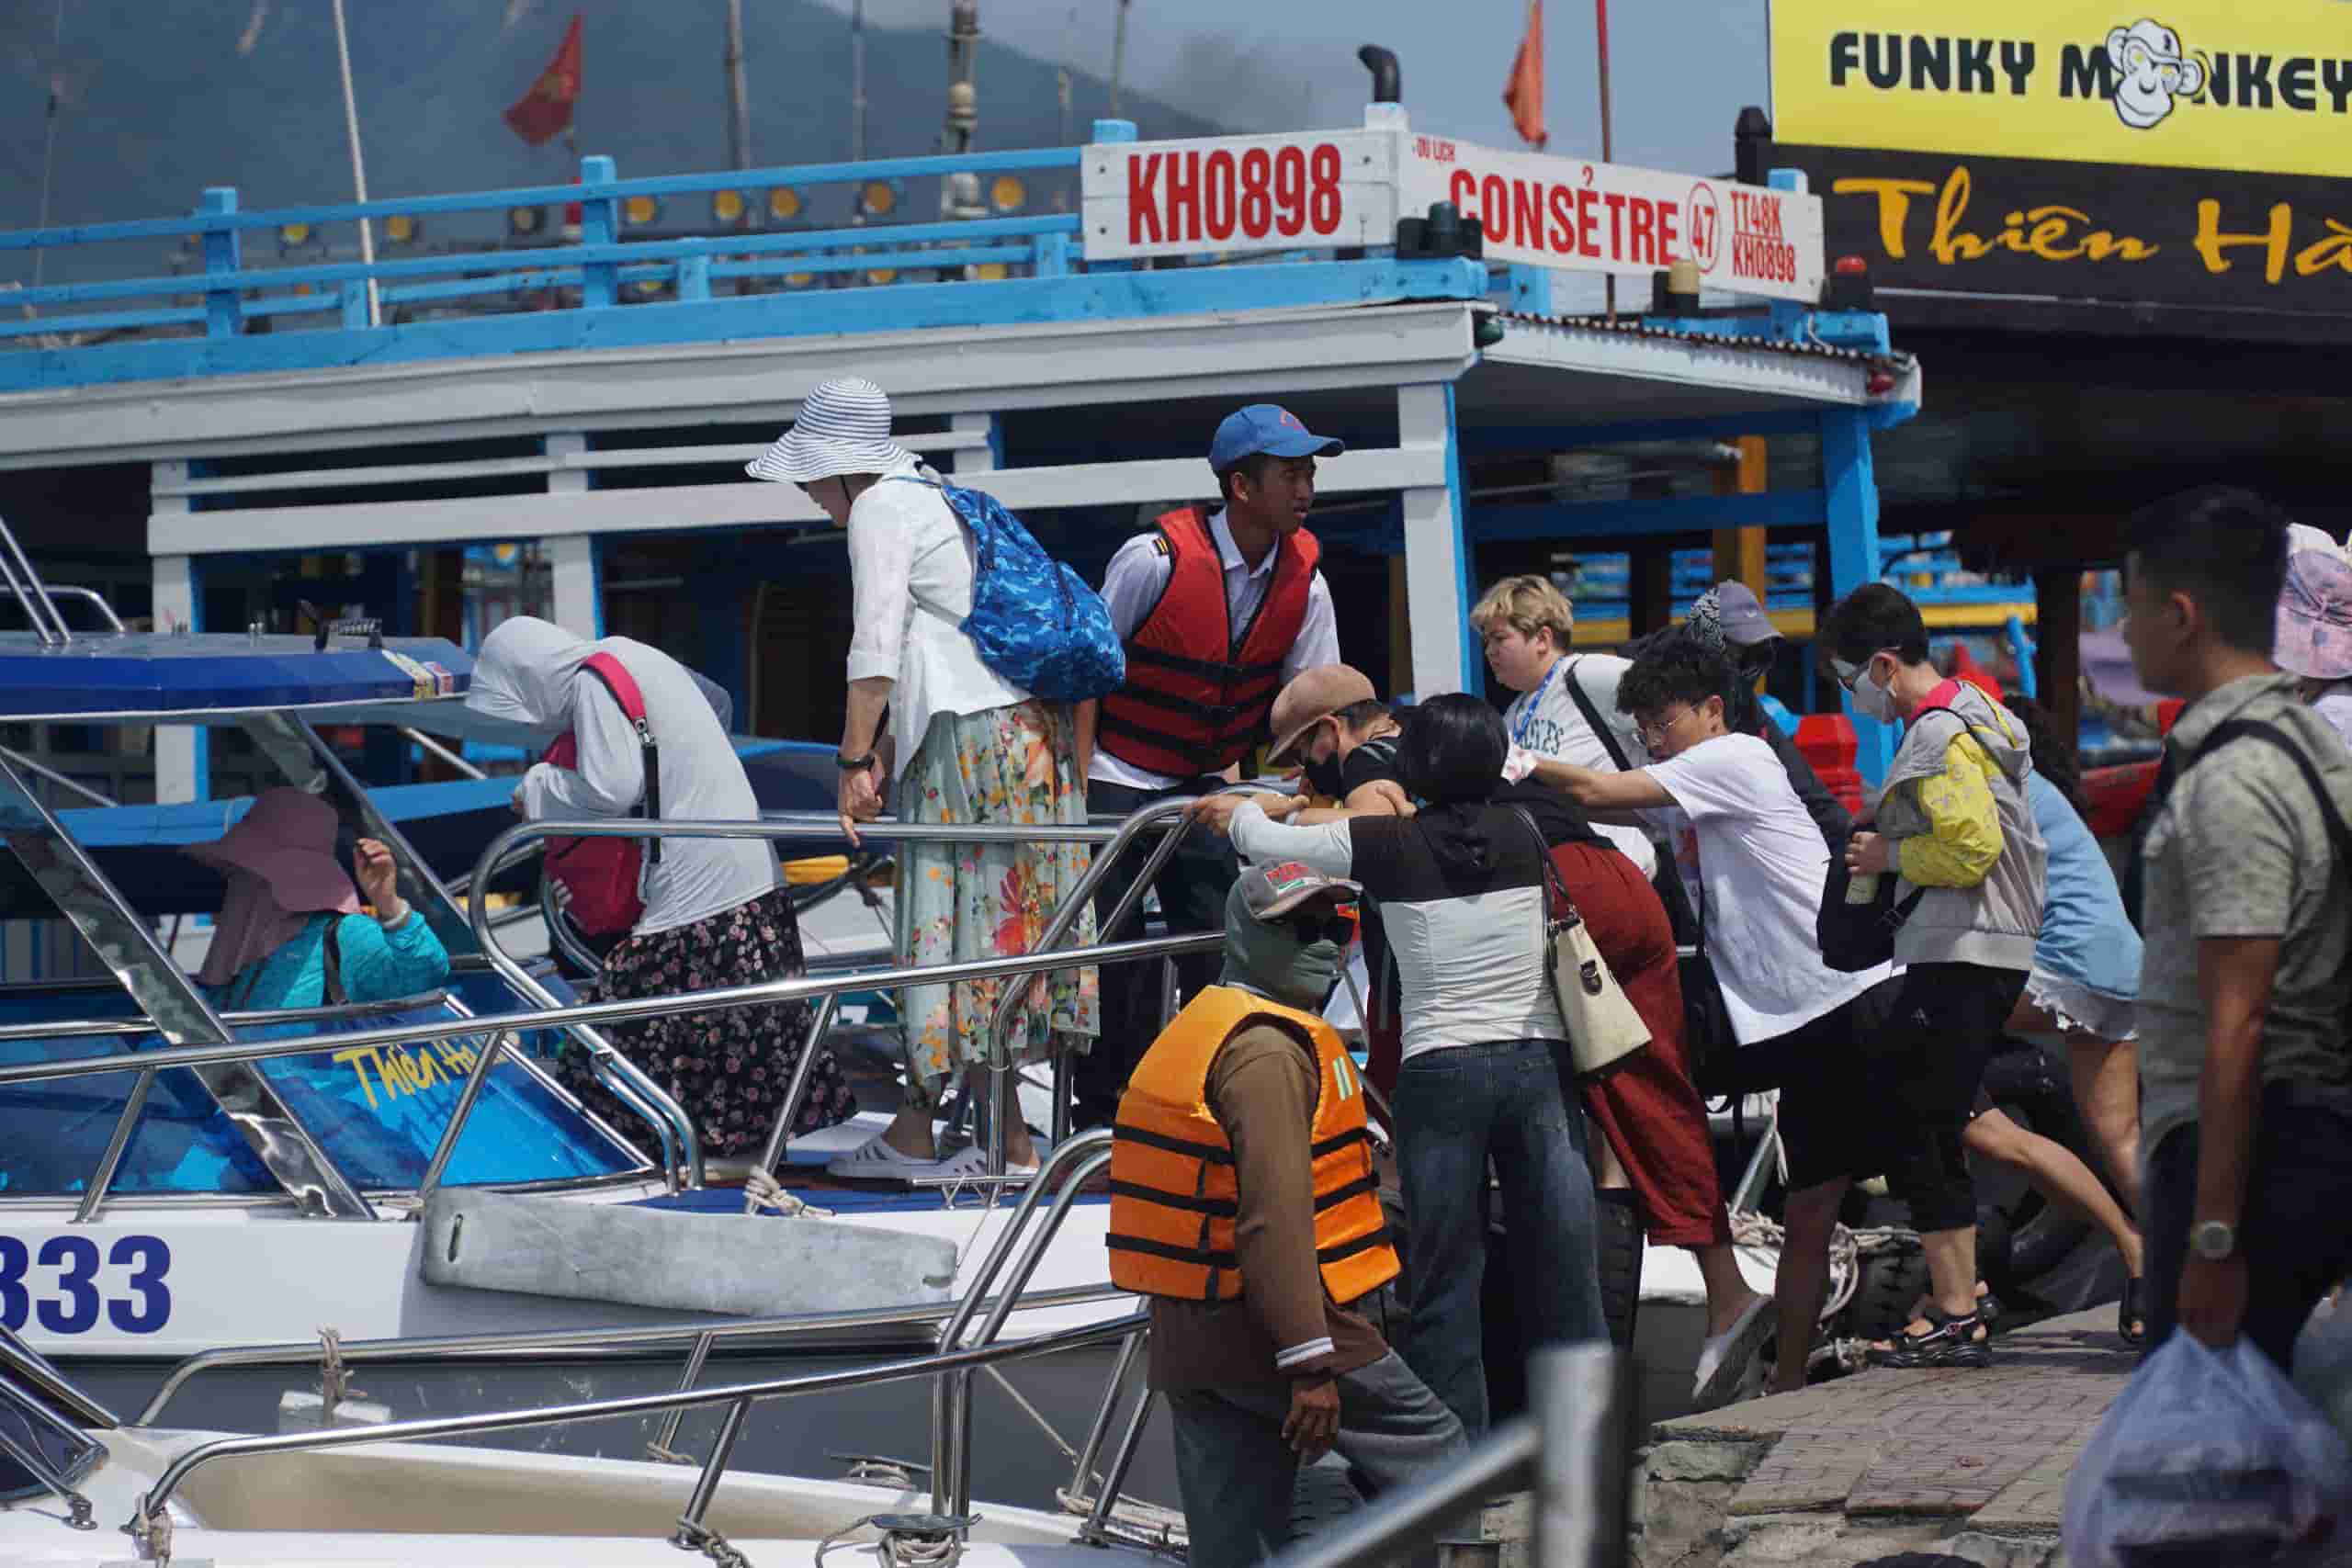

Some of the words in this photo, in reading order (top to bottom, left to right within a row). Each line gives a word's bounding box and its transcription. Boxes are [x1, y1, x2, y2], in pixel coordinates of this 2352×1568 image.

[1830, 31, 2035, 96] FUNKY
[2057, 44, 2352, 114] MNKEY
[1128, 142, 1342, 245] KH0898
[1692, 204, 1715, 258] 47
[1832, 165, 2160, 265] Thiên
[1733, 232, 1796, 284] KH0898
